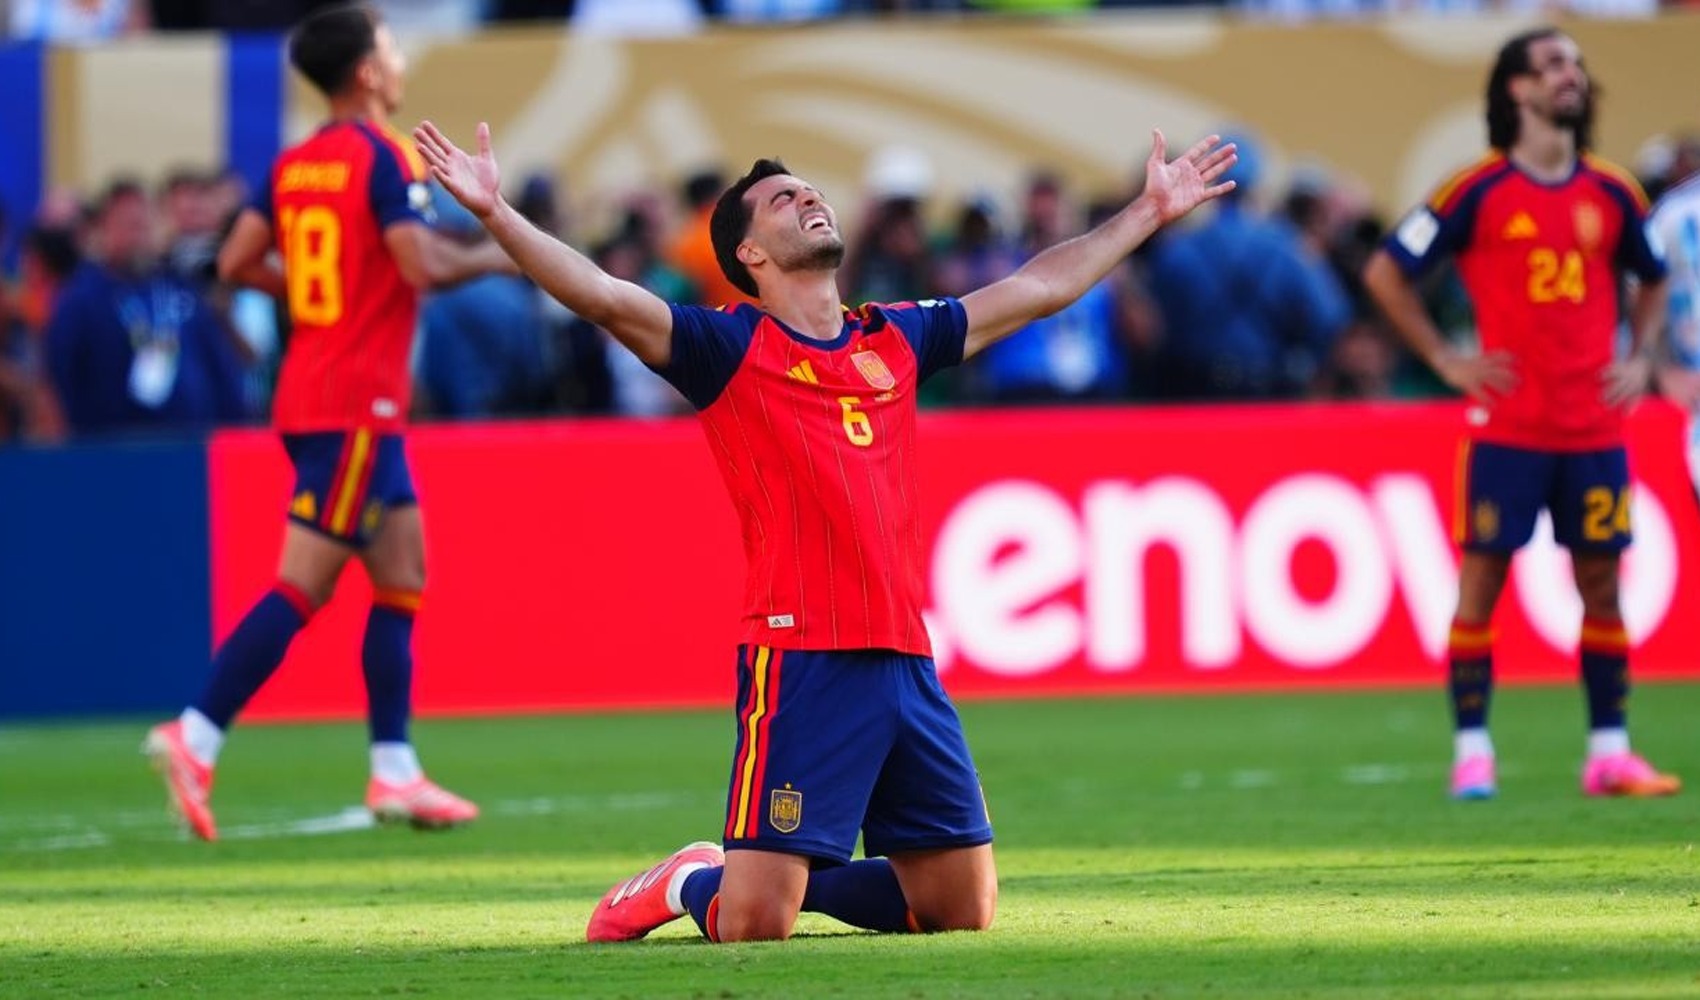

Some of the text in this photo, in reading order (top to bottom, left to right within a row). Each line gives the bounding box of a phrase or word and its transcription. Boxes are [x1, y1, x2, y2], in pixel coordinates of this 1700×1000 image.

[279, 206, 342, 326] 18
[1527, 248, 1585, 304] 24
[838, 396, 873, 447] 6
[1583, 487, 1630, 541] 24
[921, 471, 1679, 676] enovo
